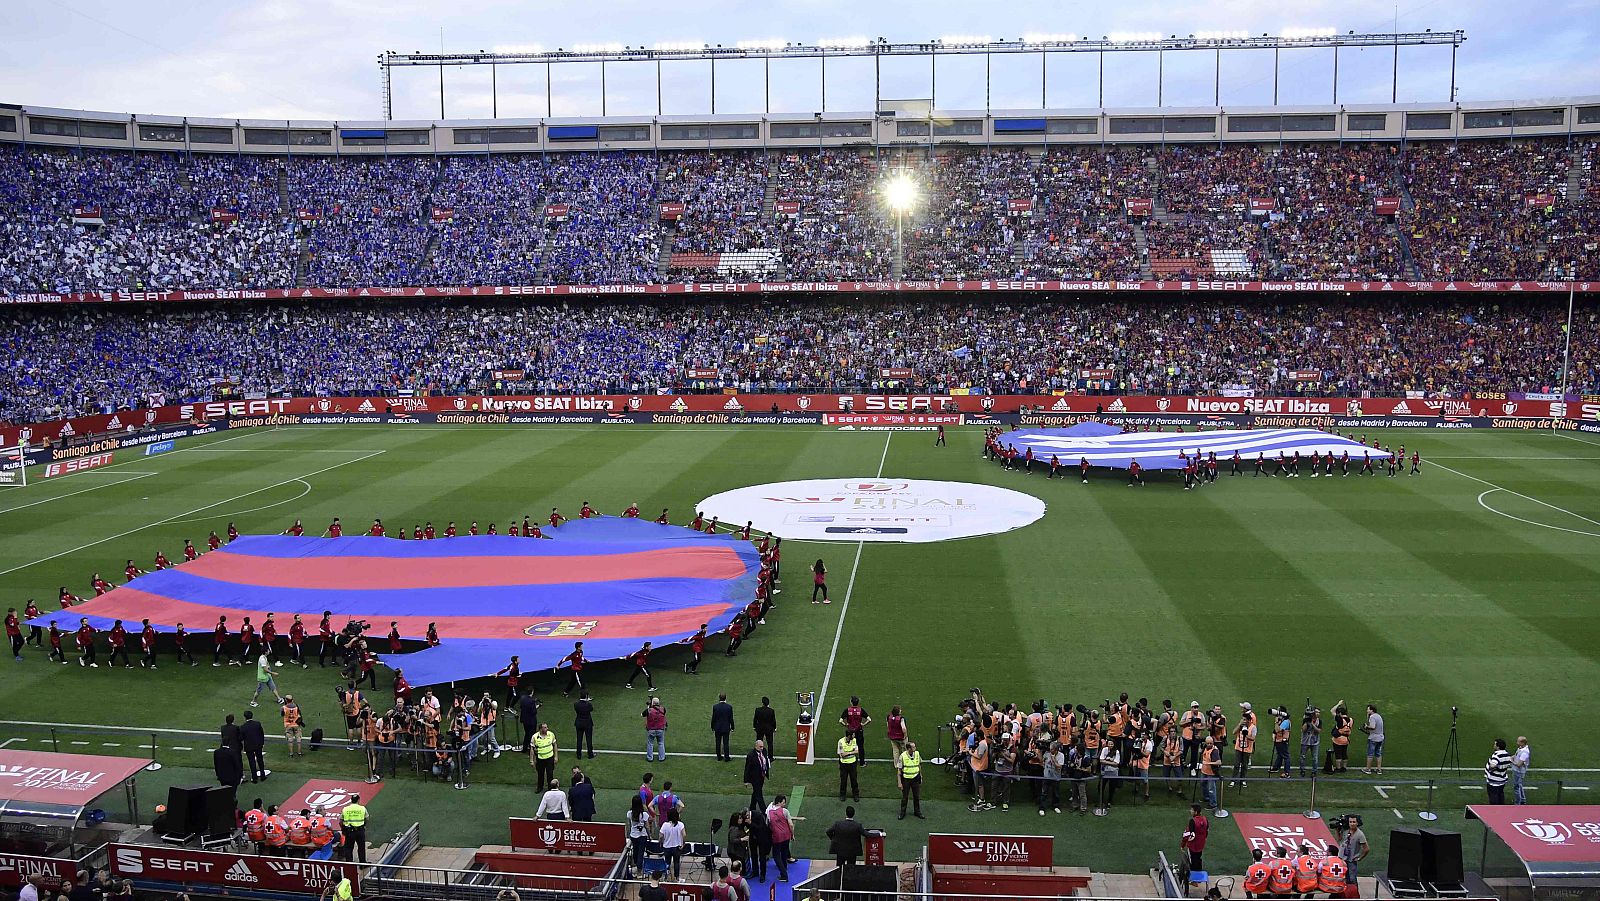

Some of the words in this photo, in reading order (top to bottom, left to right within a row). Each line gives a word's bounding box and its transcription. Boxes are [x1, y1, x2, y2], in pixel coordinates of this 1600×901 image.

[510, 286, 558, 294] SEAT
[569, 286, 598, 294] Nuevo
[599, 285, 621, 294] SEAT
[622, 284, 646, 293] Ibiza
[700, 284, 748, 292] SEAT
[760, 284, 791, 292] Nuevo
[792, 283, 816, 292] SEAT
[816, 283, 838, 292] Ibiza
[997, 282, 1048, 290] SEAT
[1060, 282, 1090, 290] Nuevo
[1092, 282, 1115, 290] SEA
[1116, 282, 1141, 290] Ibiza
[1198, 282, 1250, 290] SEAT
[1262, 282, 1293, 290] Nuevo
[1294, 282, 1319, 290] SEAT
[1320, 282, 1344, 290] Ibiza
[15, 294, 38, 303] SEAT
[39, 294, 62, 302] Ibiza
[120, 292, 170, 301] SEAT
[184, 292, 216, 300] Nuevo
[216, 291, 240, 300] SEAT
[242, 290, 266, 300] Ibiza
[404, 398, 428, 408] FINAL
[482, 397, 530, 410] Nuevo
[534, 396, 572, 410] SEAT
[575, 396, 614, 410] Ibiza
[866, 396, 953, 410] SEAT
[1187, 398, 1240, 412] Nuevo
[1244, 398, 1284, 412] SEAT
[1288, 398, 1330, 412] Ibiza
[1444, 401, 1471, 410] FINAL
[206, 400, 291, 417] SEAT
[228, 416, 261, 428] Santiago
[262, 416, 276, 425] de
[278, 414, 300, 426] Chile
[302, 416, 321, 424] desde
[322, 416, 342, 424] Madrid
[348, 416, 380, 424] Barcelona
[436, 414, 475, 425] Santiago
[476, 413, 486, 424] de
[488, 413, 510, 424] Chile
[512, 416, 531, 424] desde
[532, 416, 554, 424] Madrid
[560, 416, 593, 424] Barcelona
[652, 414, 692, 425] Santiago
[694, 413, 704, 424] de
[706, 413, 729, 424] Chile
[752, 416, 775, 424] Madrid
[782, 416, 816, 424] Barcelona
[1020, 414, 1062, 426] Santiago
[1063, 415, 1074, 425] de
[1077, 415, 1100, 424] Cile
[1156, 418, 1191, 426] Barcelona
[1254, 416, 1297, 428] Santiago
[1300, 416, 1310, 427] de
[1338, 419, 1359, 427] desde
[1360, 419, 1384, 427] Madrid
[1392, 419, 1427, 428] Barcelona
[1492, 418, 1536, 430] Santiago
[1538, 418, 1550, 428] de
[1552, 420, 1578, 430] Chile
[193, 426, 217, 436] PLUSULTRA
[52, 443, 88, 460] Santiago
[90, 443, 100, 453] de
[101, 438, 120, 451] Chile
[122, 437, 138, 447] desde
[140, 434, 156, 444] Madrid
[162, 430, 187, 440] Barcelona
[67, 454, 112, 472] SEAT
[22, 767, 106, 785] FINAL
[13, 779, 58, 789] 2017
[986, 841, 1029, 855] FINAL
[986, 854, 1009, 863] 2017
[18, 860, 62, 878] FINAL
[150, 858, 214, 872] SEAT
[224, 872, 258, 882] adidas
[304, 878, 328, 888] 2017
